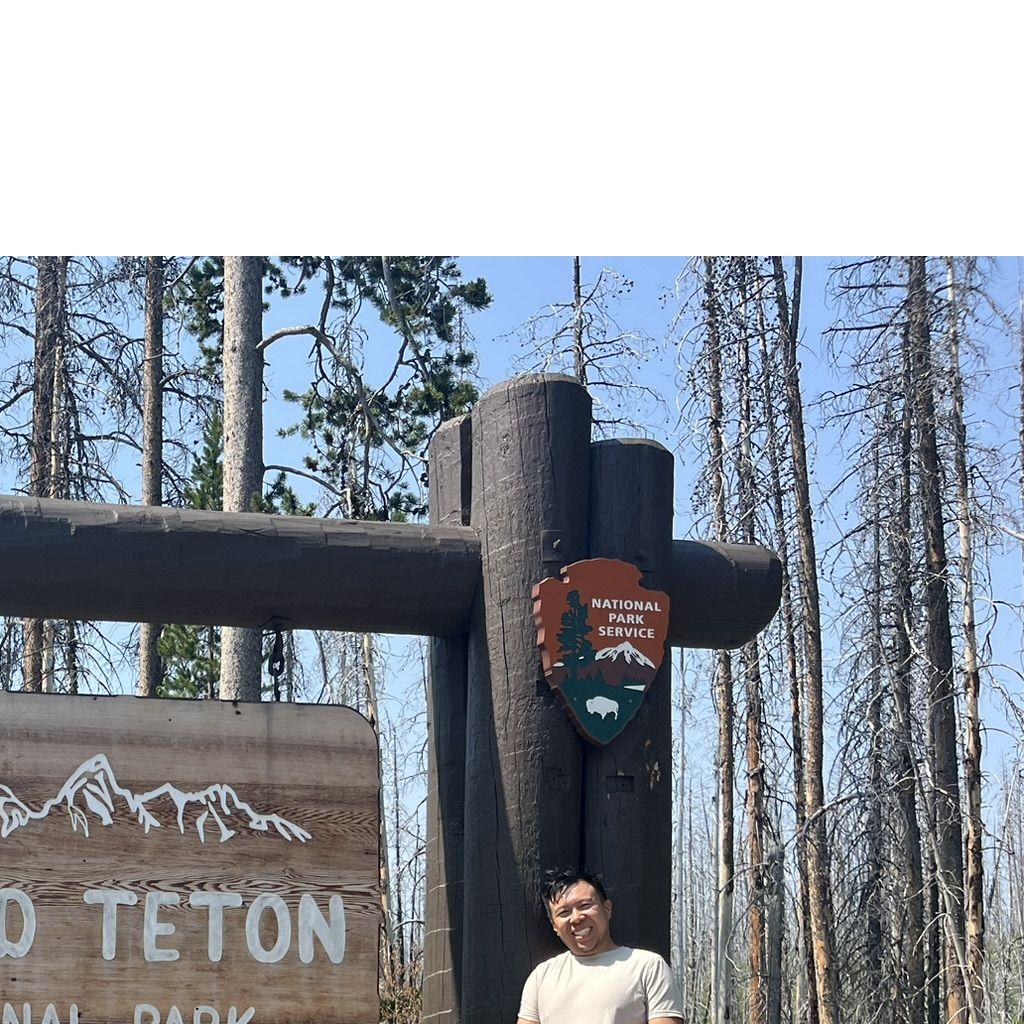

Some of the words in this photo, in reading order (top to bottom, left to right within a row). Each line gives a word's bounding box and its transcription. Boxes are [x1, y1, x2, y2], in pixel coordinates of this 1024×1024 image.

[592, 598, 662, 611] NATIONAL
[608, 613, 644, 624] PARK
[598, 626, 655, 638] SERVICE
[83, 889, 347, 965] TETON
